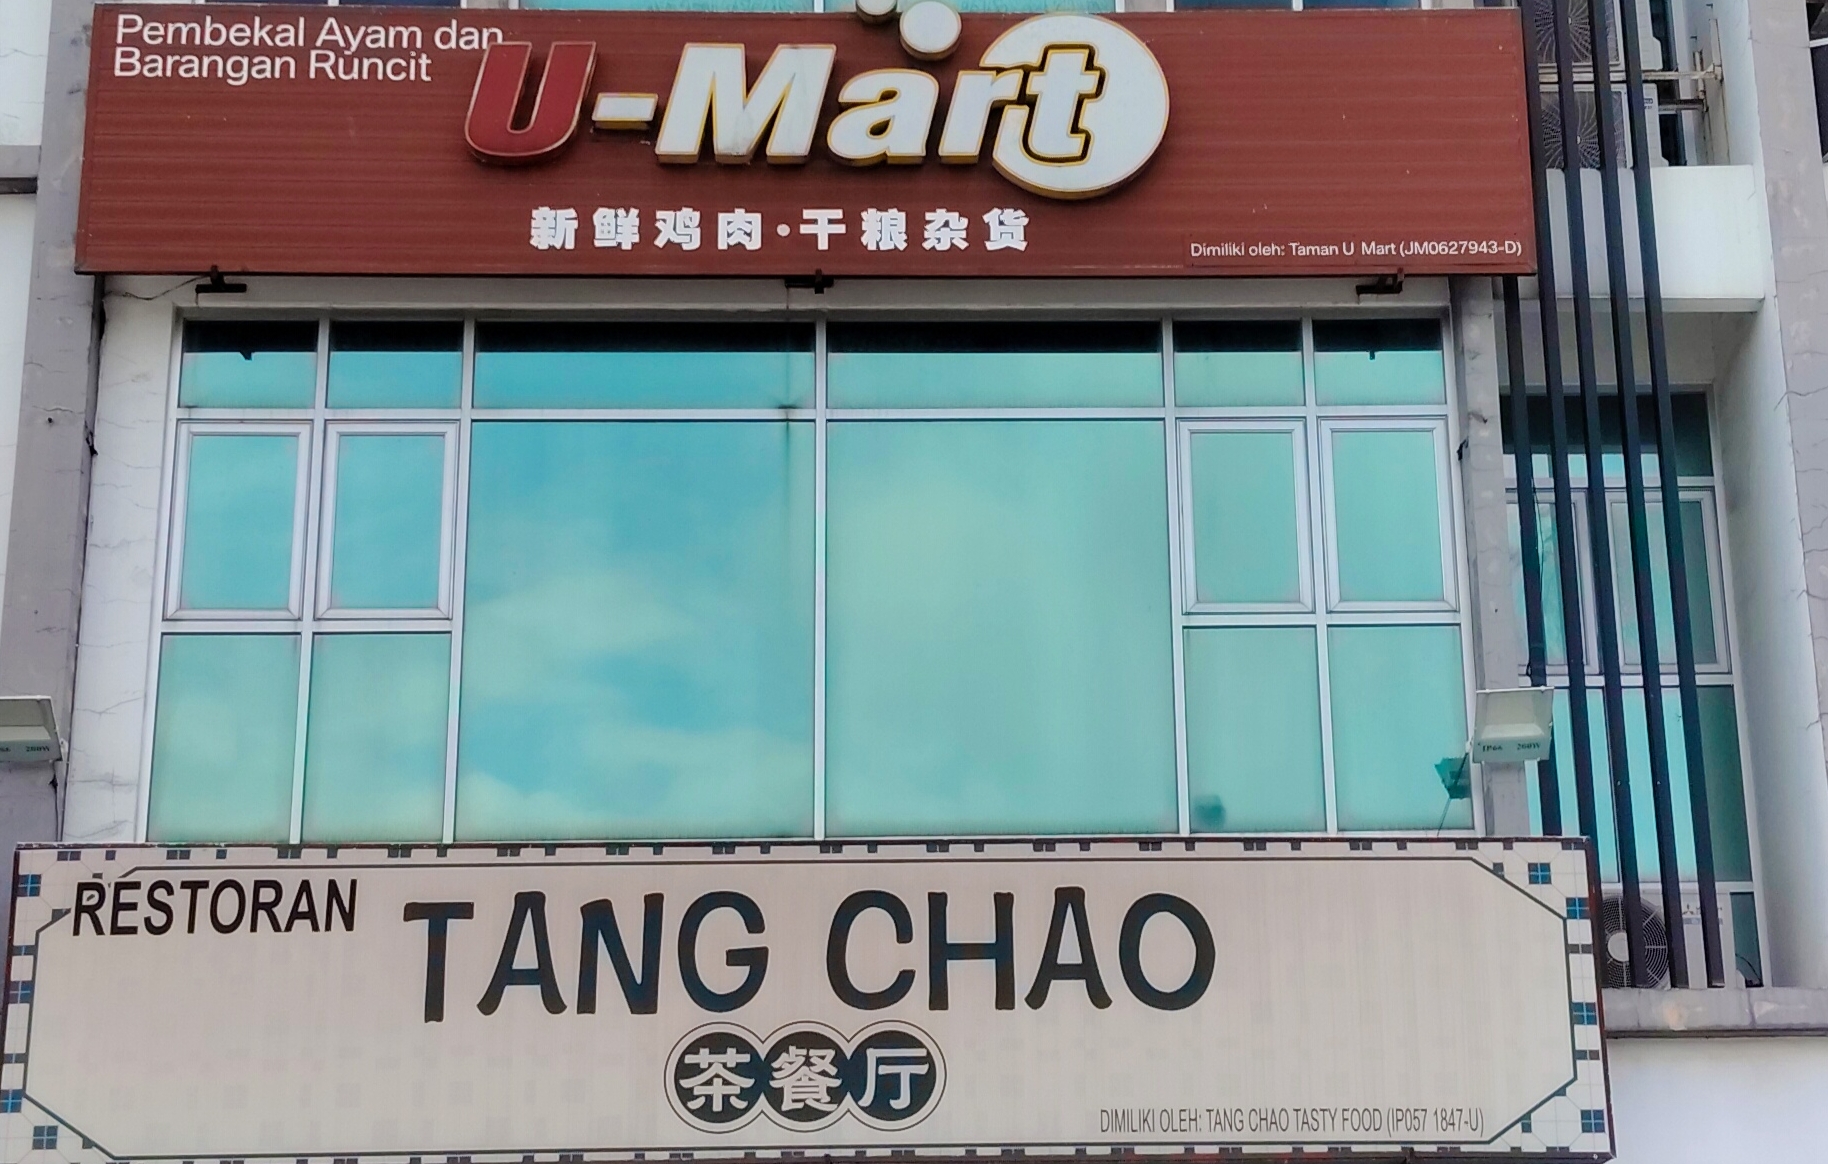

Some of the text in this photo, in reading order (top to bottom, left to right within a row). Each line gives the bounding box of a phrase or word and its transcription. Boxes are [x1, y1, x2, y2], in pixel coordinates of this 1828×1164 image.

[115, 14, 503, 54] Pembekal Ayam dan
[114, 46, 432, 85] Barangan Runcit
[464, 41, 1101, 165] U-Mart
[1191, 241, 1522, 257] Dimiliki oleh: Taman U Mart (JM0627943-D)
[72, 877, 357, 937] RESTORAN
[403, 886, 1216, 1023] TANG CHAO
[679, 1045, 930, 1112] 茶餐厅
[1100, 1109, 1156, 1133] DIMILIKI
[1160, 1108, 1202, 1132] OLEH:
[1205, 1108, 1244, 1132] TANG
[1249, 1107, 1290, 1132] CHAO
[1293, 1108, 1339, 1132] TASTY
[1342, 1107, 1383, 1132] FOOD
